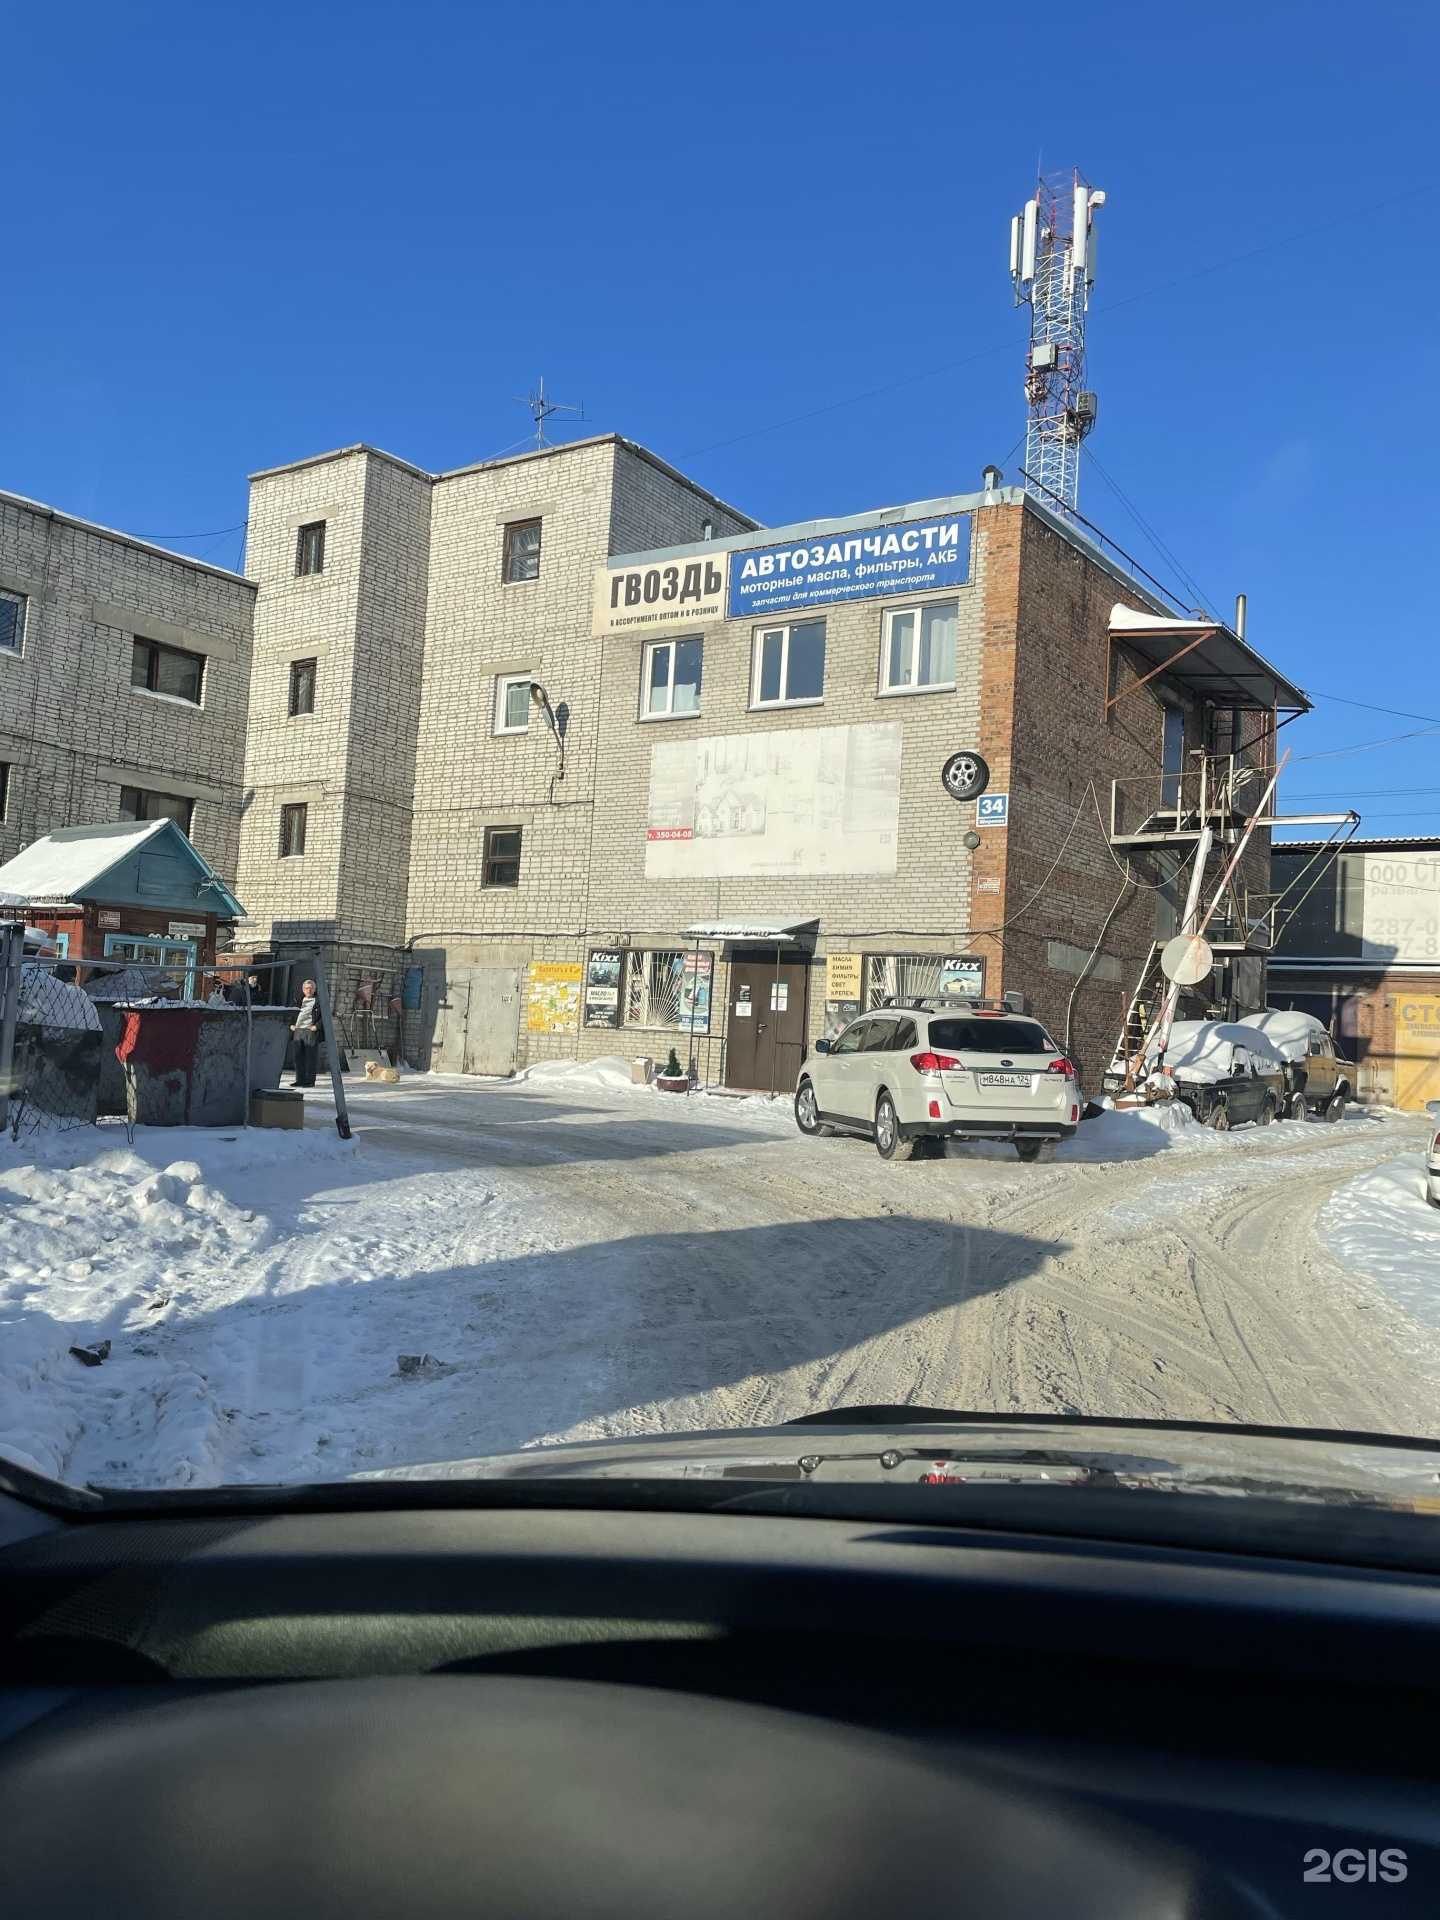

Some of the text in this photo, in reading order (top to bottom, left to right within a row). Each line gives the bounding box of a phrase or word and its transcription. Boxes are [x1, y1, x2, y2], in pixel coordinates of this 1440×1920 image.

[741, 523, 959, 579] АВТОЗАПЧАСТИ
[610, 561, 722, 609] ГВОЗДЬ
[740, 549, 958, 594] моторные масла, фильтры, АКБ
[752, 573, 936, 607] запчасти для коммерческого транспорта
[616, 613, 658, 626] АССОРТИМЕНТЕ
[659, 610, 680, 620] ОПТОМ
[691, 605, 719, 616] РОЗНИЦУ
[981, 798, 1004, 815] 34
[592, 952, 619, 962] Kixx
[943, 960, 981, 971] Kixx
